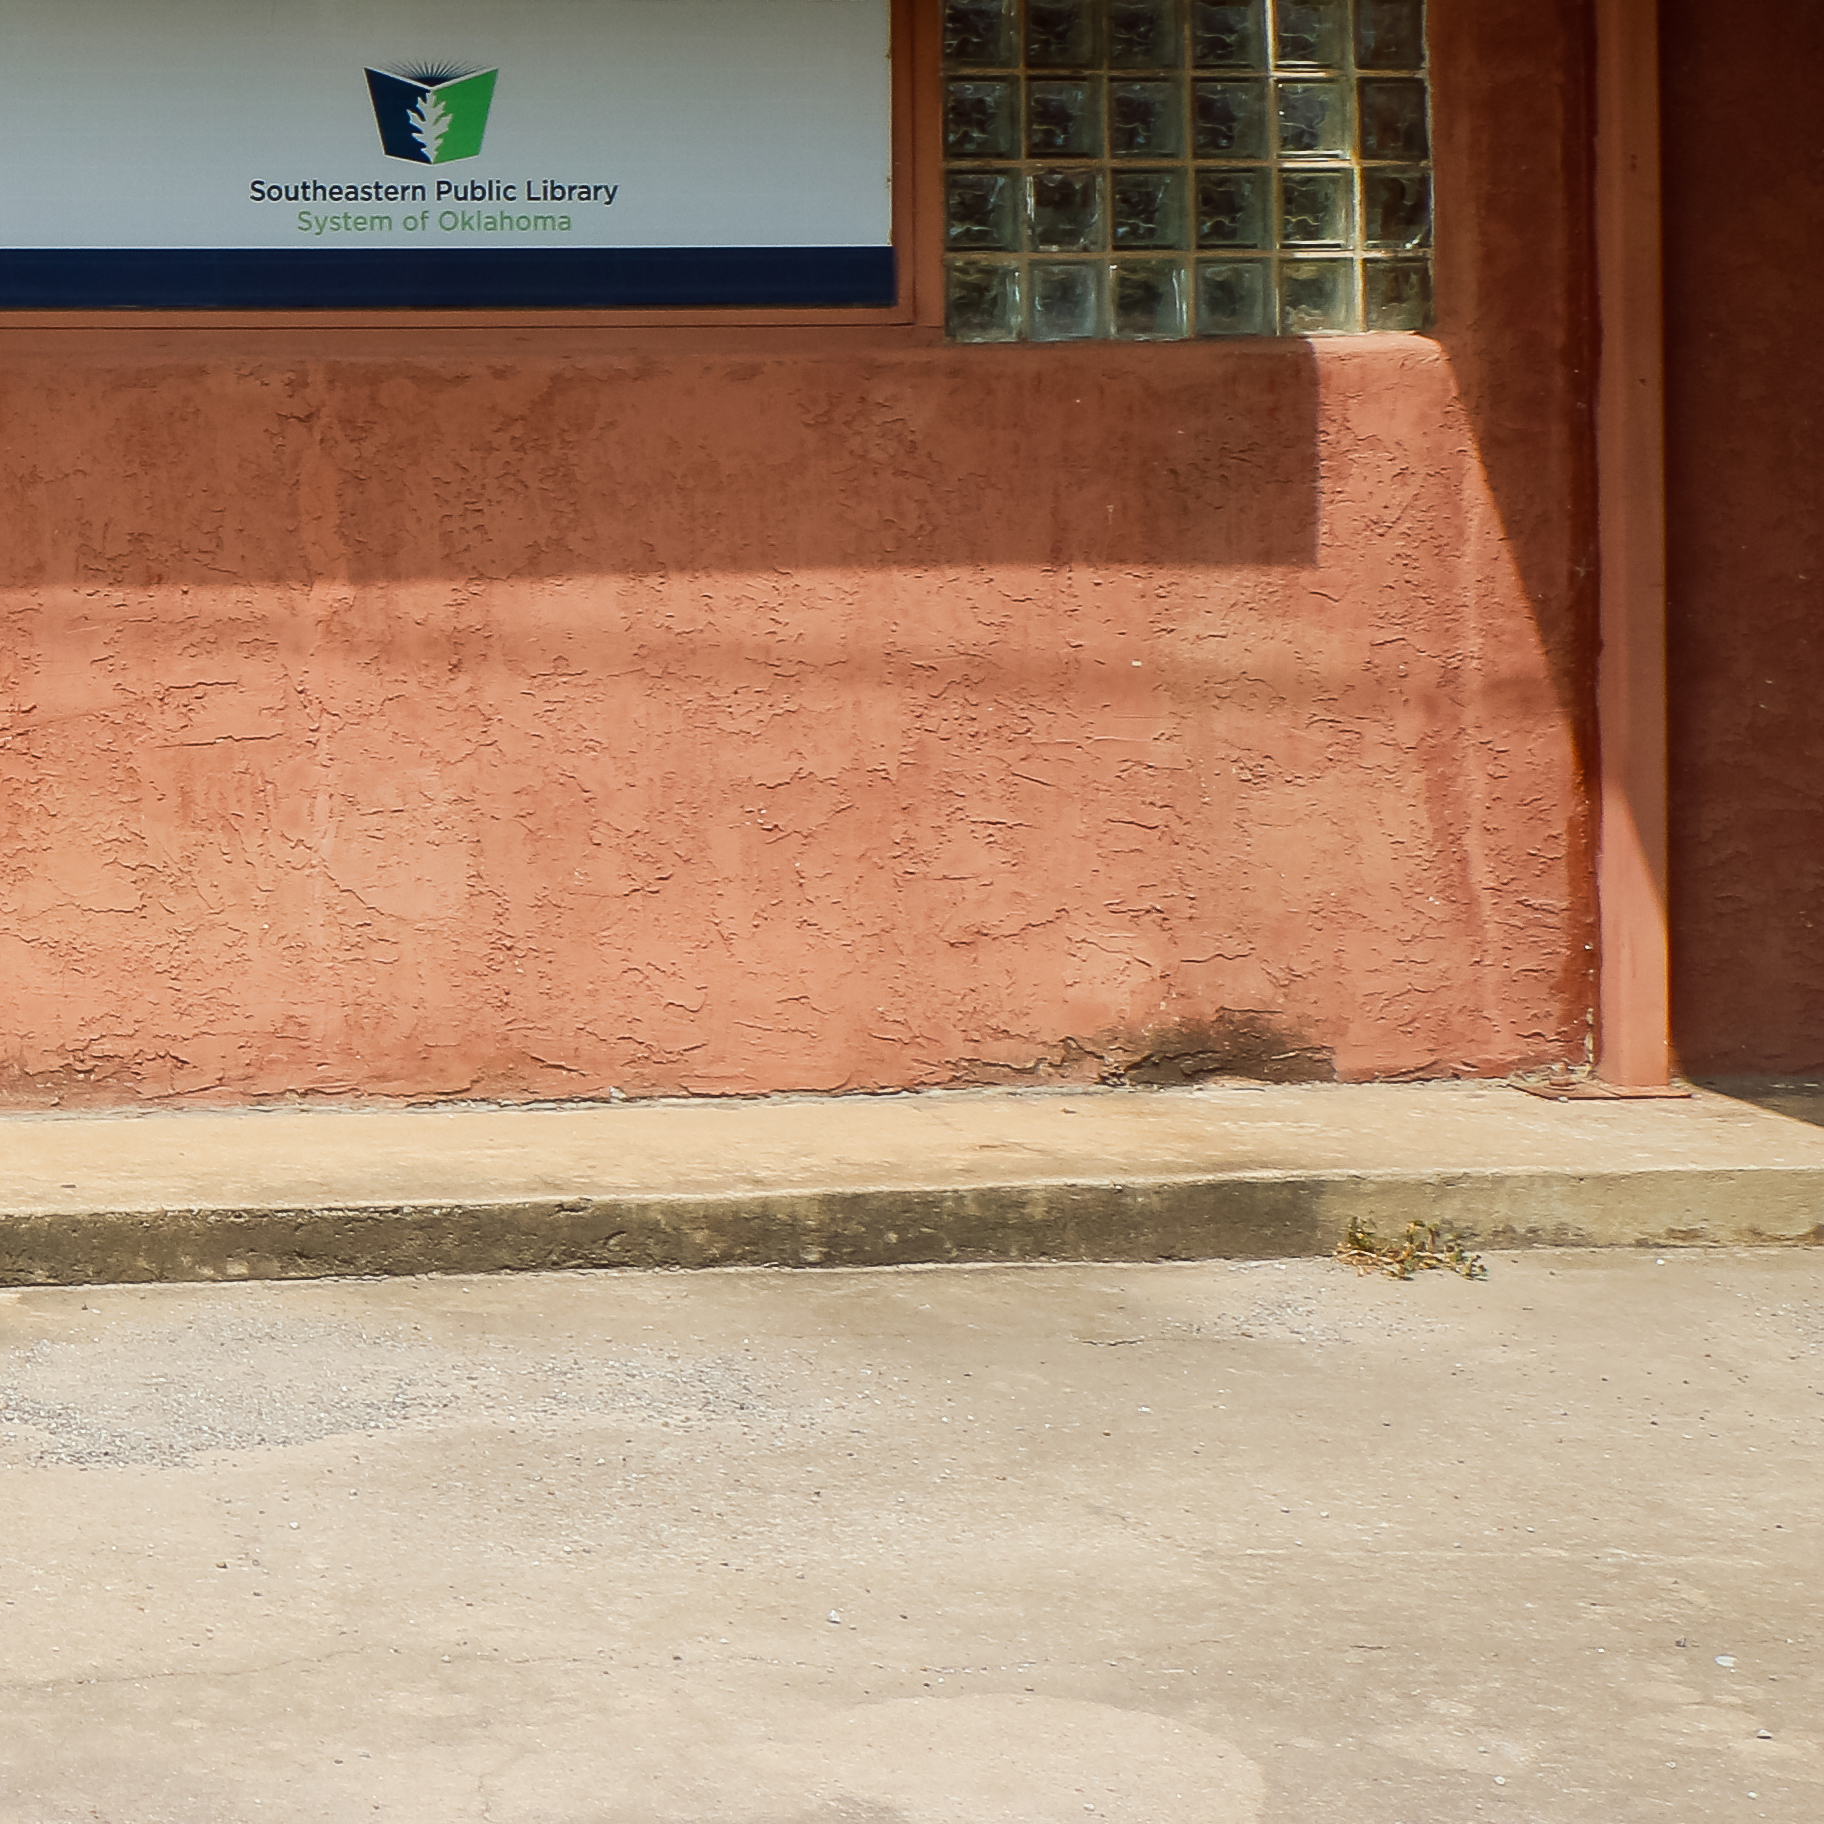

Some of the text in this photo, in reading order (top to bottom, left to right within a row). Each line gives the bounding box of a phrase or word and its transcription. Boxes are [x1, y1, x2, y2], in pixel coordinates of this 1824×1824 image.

[250, 179, 619, 205] Southeastern Public Library
[297, 210, 572, 235] System of Oklahoma
